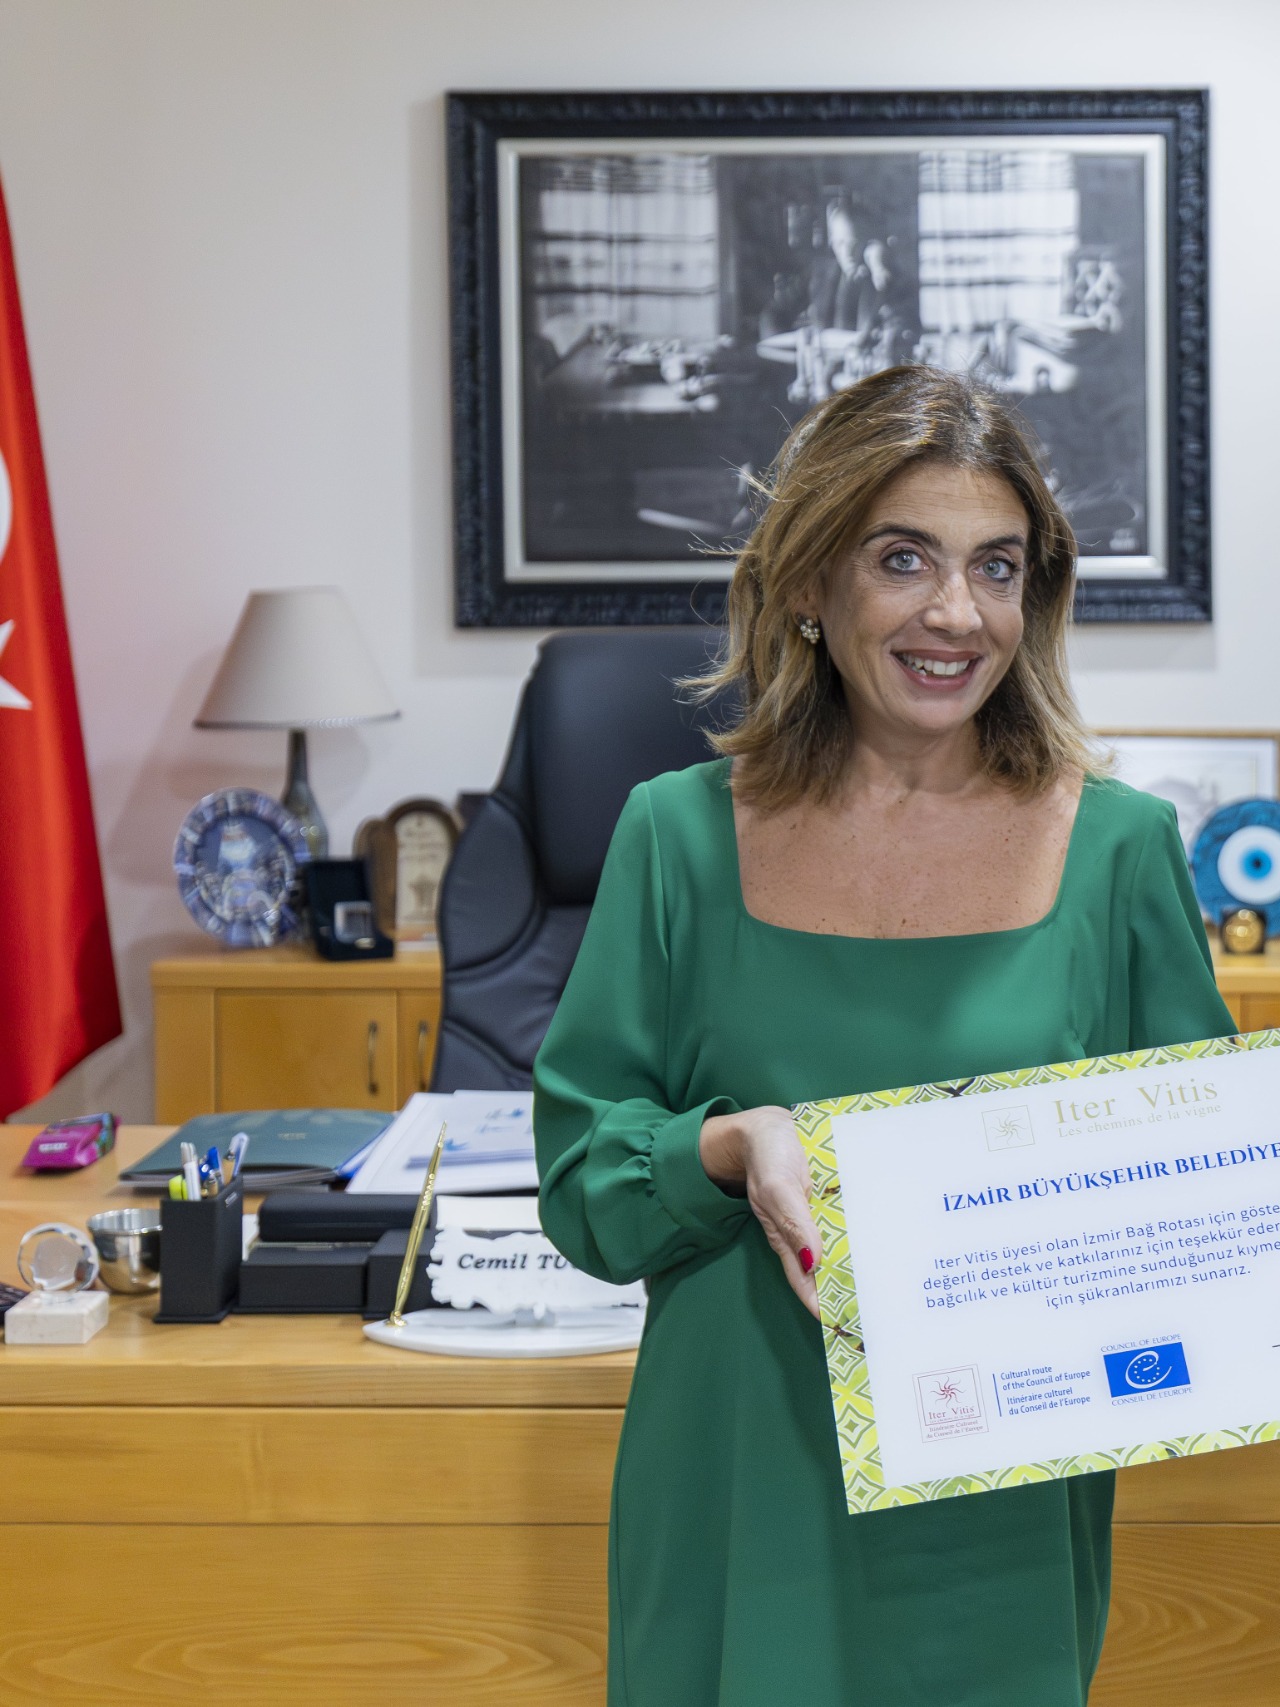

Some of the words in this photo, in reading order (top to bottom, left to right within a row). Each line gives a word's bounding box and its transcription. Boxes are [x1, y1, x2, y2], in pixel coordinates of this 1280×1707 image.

[1054, 1095, 1116, 1123] Iter
[1137, 1078, 1218, 1109] Vitis
[1058, 1127, 1082, 1138] Les
[1088, 1117, 1143, 1133] chemins
[1148, 1112, 1162, 1123] de
[1168, 1110, 1180, 1120] la
[1186, 1104, 1222, 1118] vigne
[943, 1186, 1013, 1211] İZMİR
[1018, 1161, 1171, 1199] BÜYÜKŞEHİR
[935, 1256, 961, 1269] Iter
[964, 1250, 998, 1264] Vitis
[1003, 1242, 1041, 1260] üyesi
[1046, 1238, 1078, 1251] olan
[1082, 1230, 1121, 1245] İzmir
[1126, 1223, 1155, 1238] Bağ
[1158, 1217, 1205, 1232] Rotası
[1209, 1212, 1235, 1226] için
[457, 1253, 527, 1269] Cemil
[924, 1272, 976, 1290] değerli
[981, 1262, 1032, 1280] destek
[1036, 1261, 1053, 1272] ve
[1057, 1247, 1143, 1268] katkılarınız
[1147, 1239, 1174, 1254] için
[1178, 1228, 1243, 1248] teşekkür
[926, 1287, 987, 1308] bağcılık
[991, 1286, 1008, 1297] ve
[1013, 1277, 1059, 1294] kültür
[1063, 1263, 1136, 1286] turizmine
[1141, 1249, 1234, 1273] sunduğunuz
[1046, 1293, 1074, 1309] için
[1078, 1276, 1187, 1305] şükranlarımızı
[1192, 1265, 1250, 1283] sunarız.
[1100, 1342, 1137, 1352] COUNCIL
[1153, 1334, 1181, 1343] EUROPE
[1000, 1368, 1030, 1380] Cultural
[1032, 1366, 1052, 1375] route
[1003, 1383, 1010, 1391] of
[1012, 1381, 1024, 1389] the
[1026, 1375, 1053, 1387] Council
[1055, 1374, 1063, 1382] of
[1065, 1370, 1090, 1380] Europe
[1007, 1393, 1042, 1405] Itinéraire
[1044, 1387, 1073, 1398] culturel
[1112, 1396, 1144, 1406] CONSEIL
[951, 1406, 974, 1415] Vitis
[1009, 1406, 1019, 1415] du
[1020, 1401, 1047, 1413] Conseil
[1049, 1400, 1058, 1408] de
